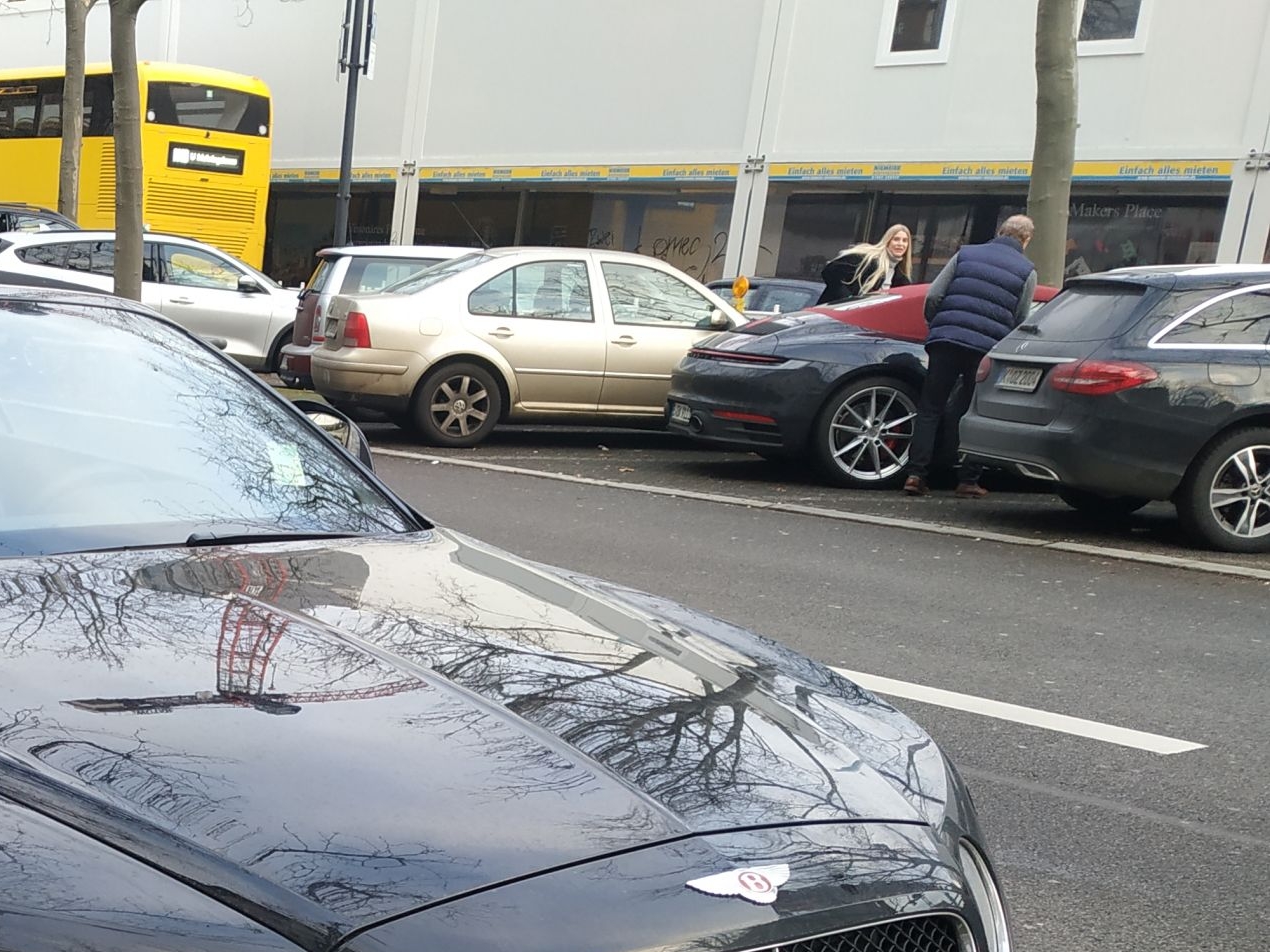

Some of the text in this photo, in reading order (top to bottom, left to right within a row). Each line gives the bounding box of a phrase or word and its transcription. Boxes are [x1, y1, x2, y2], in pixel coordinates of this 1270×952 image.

[662, 168, 730, 177] Einfach alles mieten
[787, 167, 863, 176] Einfach alles mieten
[941, 166, 1029, 175] Einfach alles mieten
[1119, 166, 1219, 175] Einfach alles mieten
[1071, 203, 1163, 219] Makers Place
